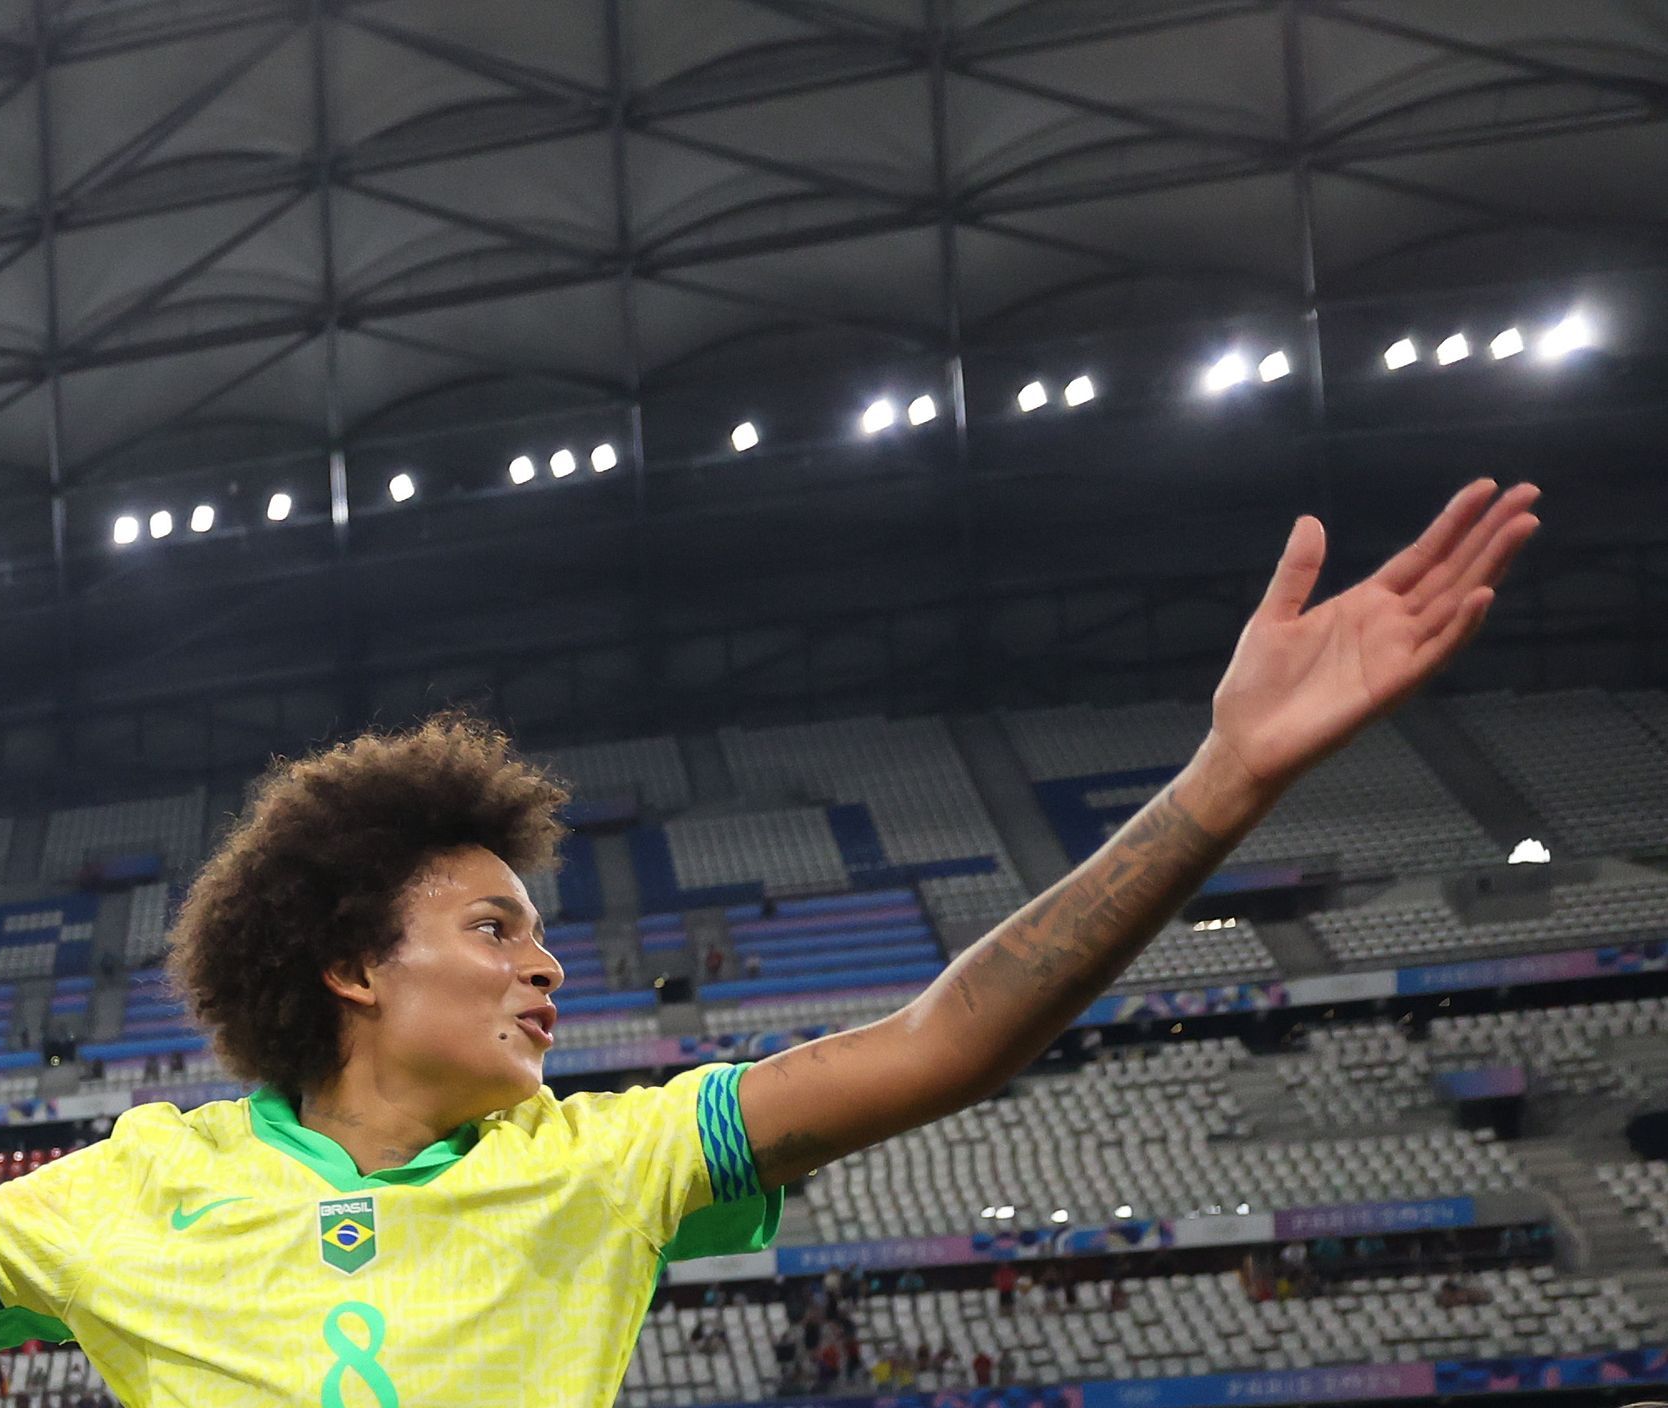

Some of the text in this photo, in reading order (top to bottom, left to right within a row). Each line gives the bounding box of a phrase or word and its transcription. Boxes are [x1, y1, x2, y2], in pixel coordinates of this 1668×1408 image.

[320, 1201, 373, 1217] BRASIL
[1291, 1205, 1455, 1231] PARIS 2024
[801, 1247, 871, 1267] PARIS
[1226, 1371, 1401, 1398] PARIS 2024
